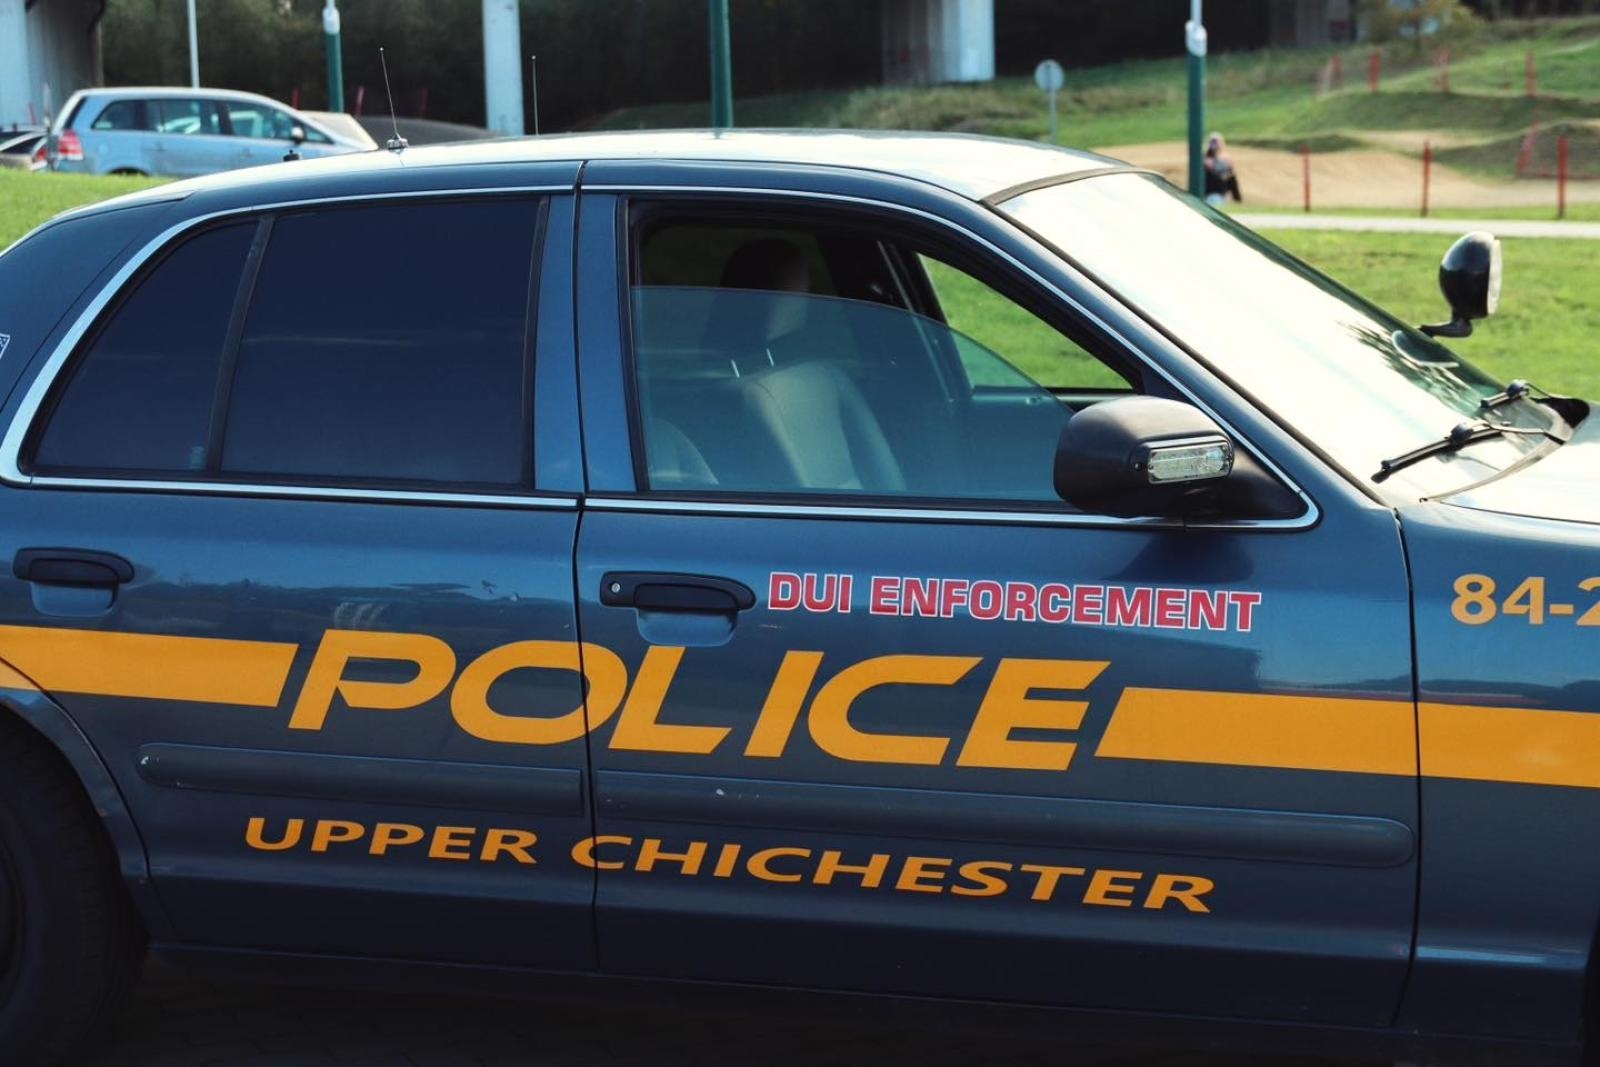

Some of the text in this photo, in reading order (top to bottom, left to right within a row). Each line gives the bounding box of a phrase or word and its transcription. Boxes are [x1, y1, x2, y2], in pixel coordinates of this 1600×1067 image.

[768, 571, 1262, 632] DUI ENFORCEMENT
[288, 628, 1110, 771] POLICE
[245, 816, 1214, 913] UPPER CHICHESTER
